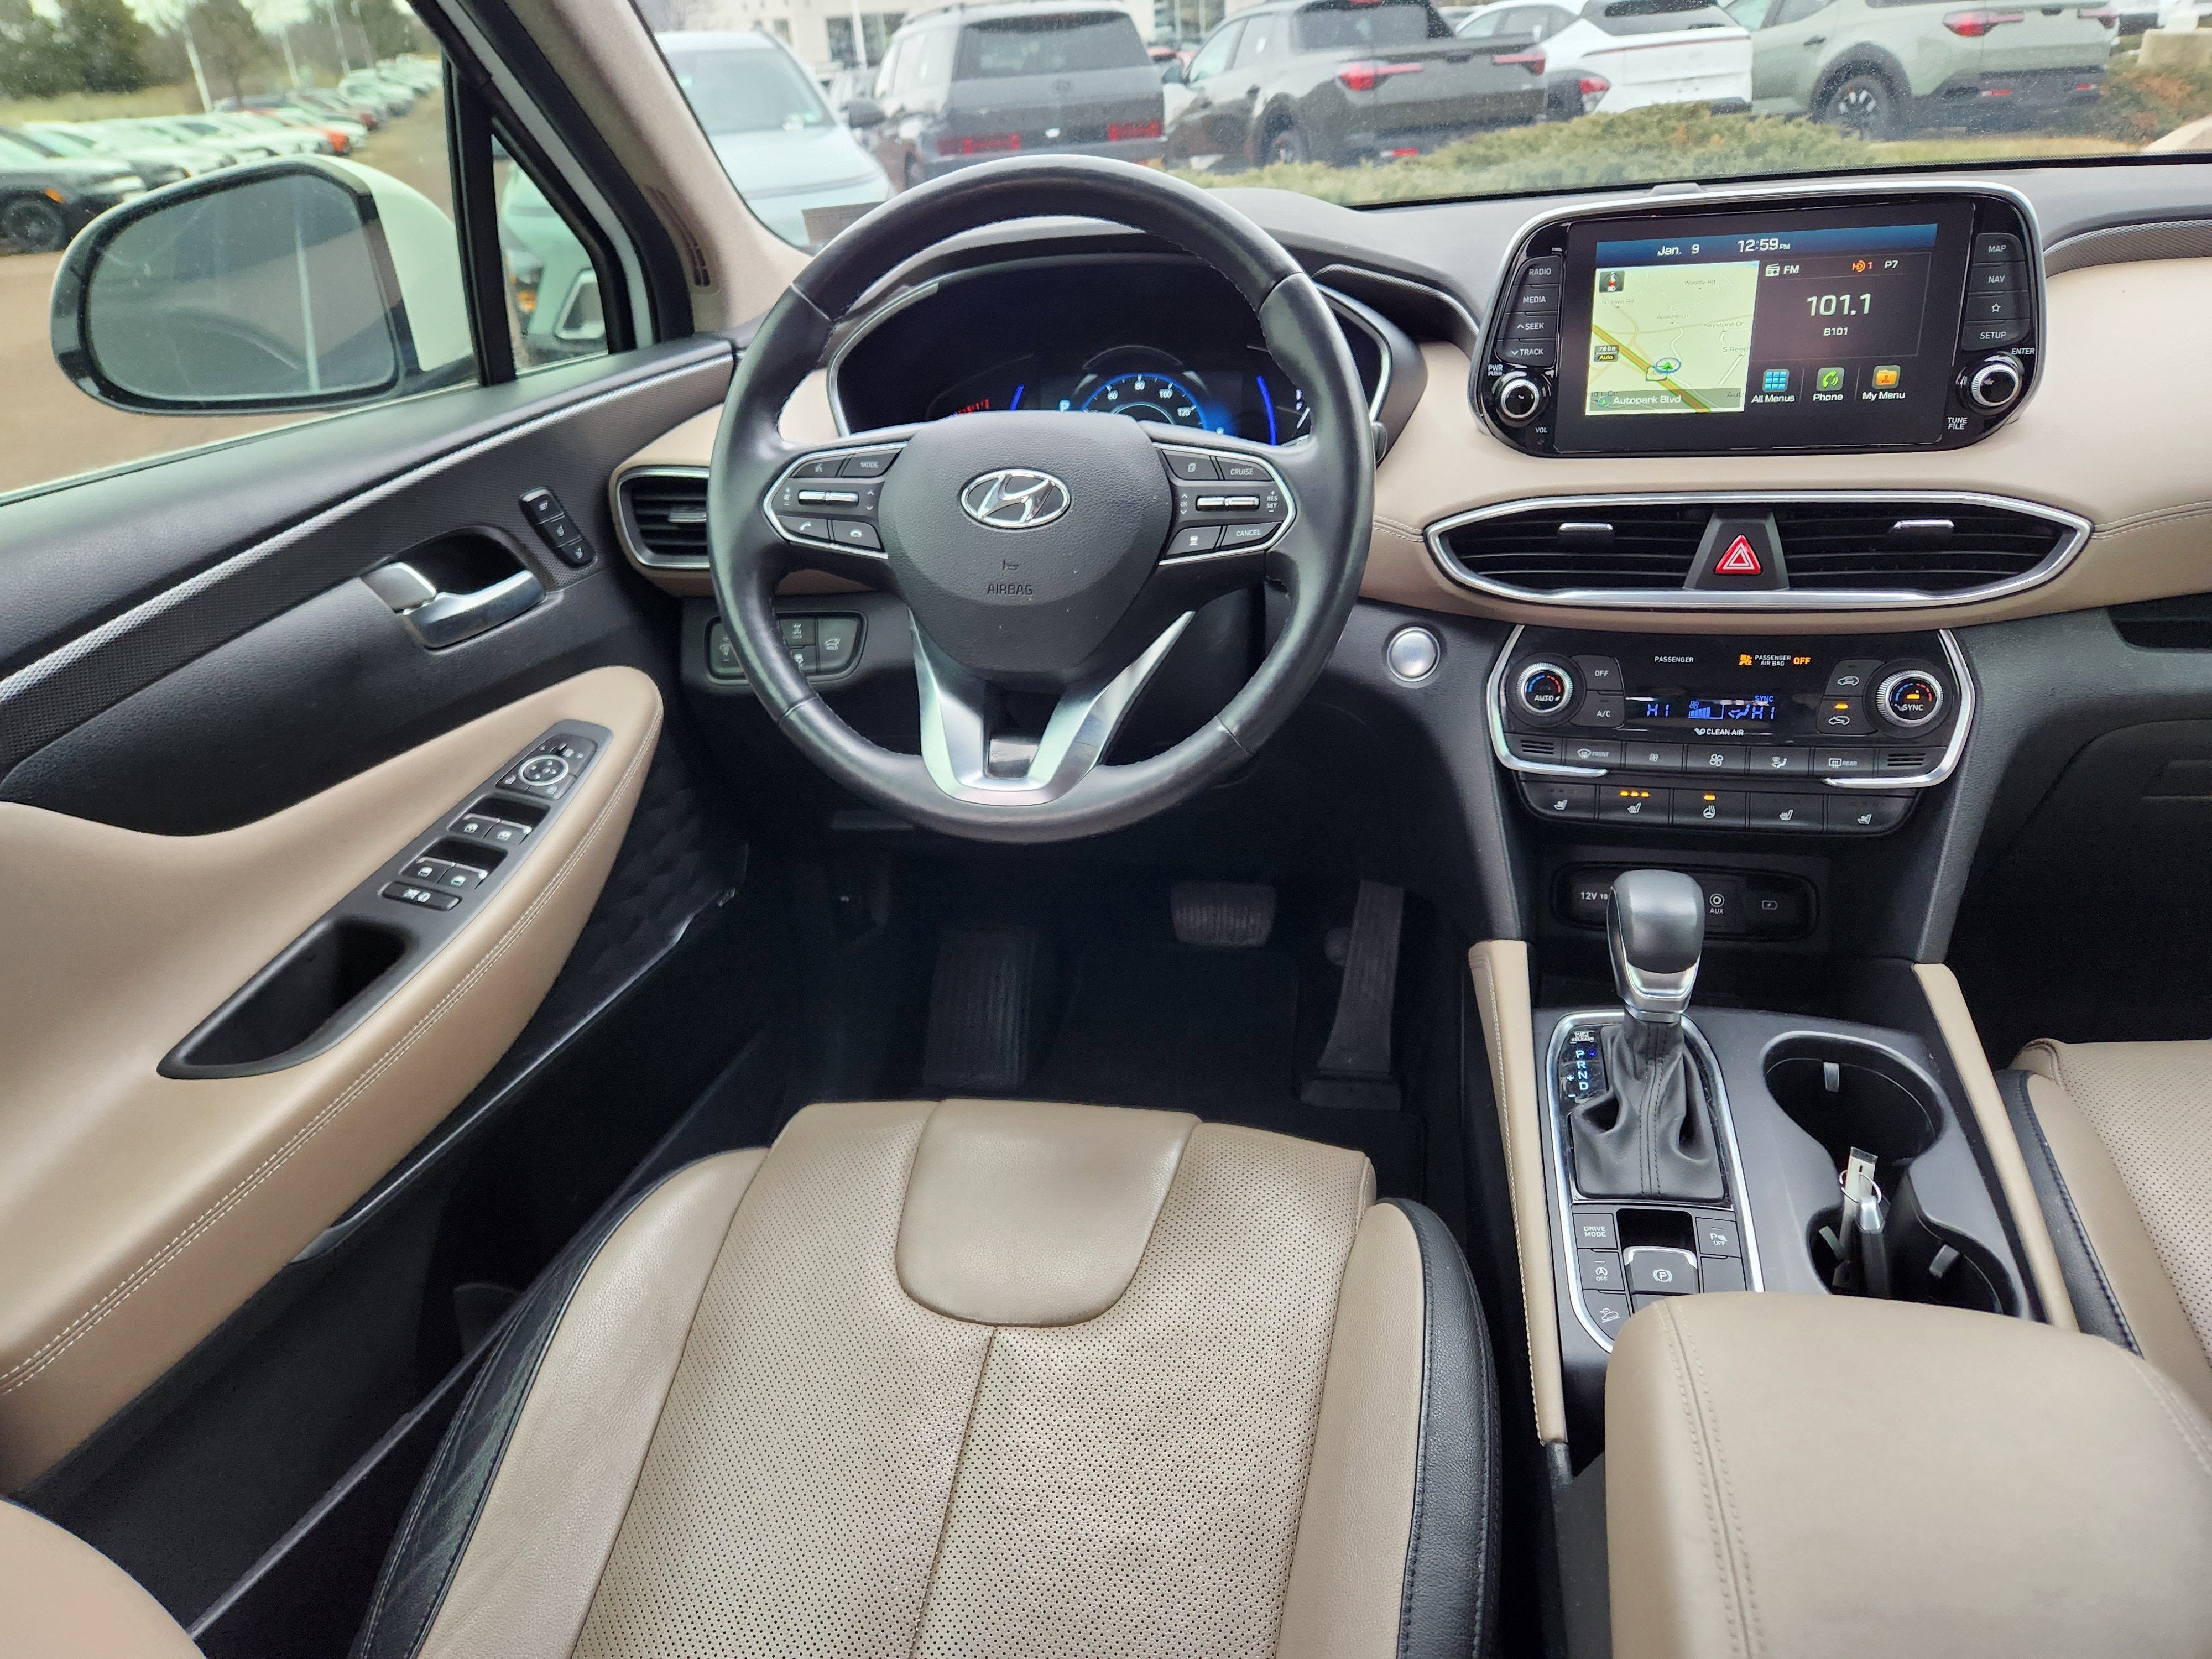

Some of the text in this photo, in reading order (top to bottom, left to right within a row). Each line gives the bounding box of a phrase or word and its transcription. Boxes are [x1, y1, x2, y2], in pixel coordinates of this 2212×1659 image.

[1691, 244, 1700, 254] 9
[1884, 260, 1899, 269] P7
[1783, 265, 1799, 274] FM
[1989, 275, 2006, 284] NAV
[1807, 293, 1872, 316] 101.1
[1824, 327, 1848, 336] B101
[1980, 331, 2006, 340] SETUP
[1134, 380, 1145, 391] 80
[1107, 390, 1118, 400] 60
[1159, 389, 1173, 398] 100
[1751, 393, 1795, 403] All Menus
[1813, 392, 1843, 401] Phone
[1863, 390, 1906, 401] My Menu
[1613, 395, 1681, 406] Autopark Blvd
[1059, 399, 1071, 412] P
[1177, 407, 1191, 416] 120
[987, 583, 1033, 596] AIRBAG
[1793, 656, 1811, 665] OFF
[1580, 891, 1598, 900] 12V
[1575, 1050, 1585, 1059] P
[1577, 1061, 1587, 1069] R
[1578, 1071, 1588, 1079] N
[1579, 1082, 1589, 1091] D
